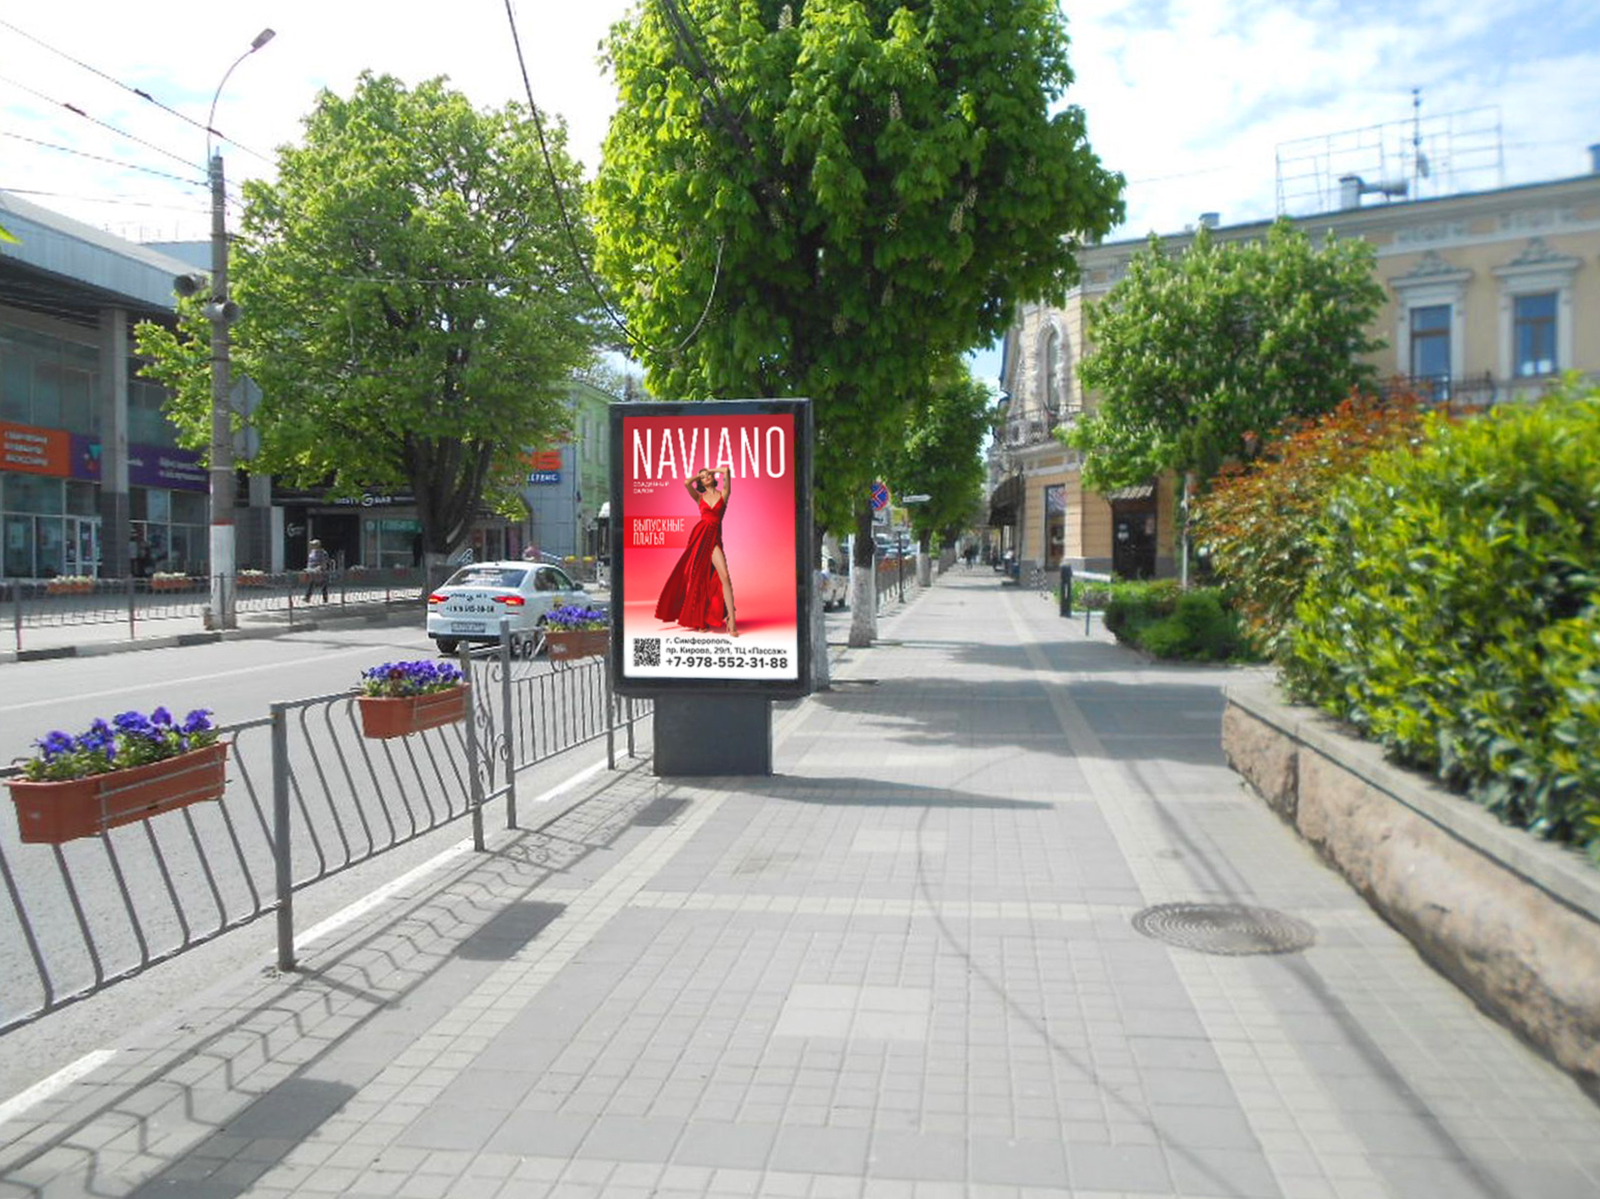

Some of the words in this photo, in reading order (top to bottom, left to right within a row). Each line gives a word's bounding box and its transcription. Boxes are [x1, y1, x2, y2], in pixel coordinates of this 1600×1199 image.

[633, 426, 785, 479] NAVIANO
[633, 518, 685, 532] ВЫПУСКНЫЕ
[633, 532, 665, 546] ПЛАТЬЯ
[674, 637, 732, 646] Симферополь,
[680, 647, 712, 655] Кирова,
[734, 647, 746, 656] ТЦ
[666, 656, 788, 668] +7-978-552-31-88
